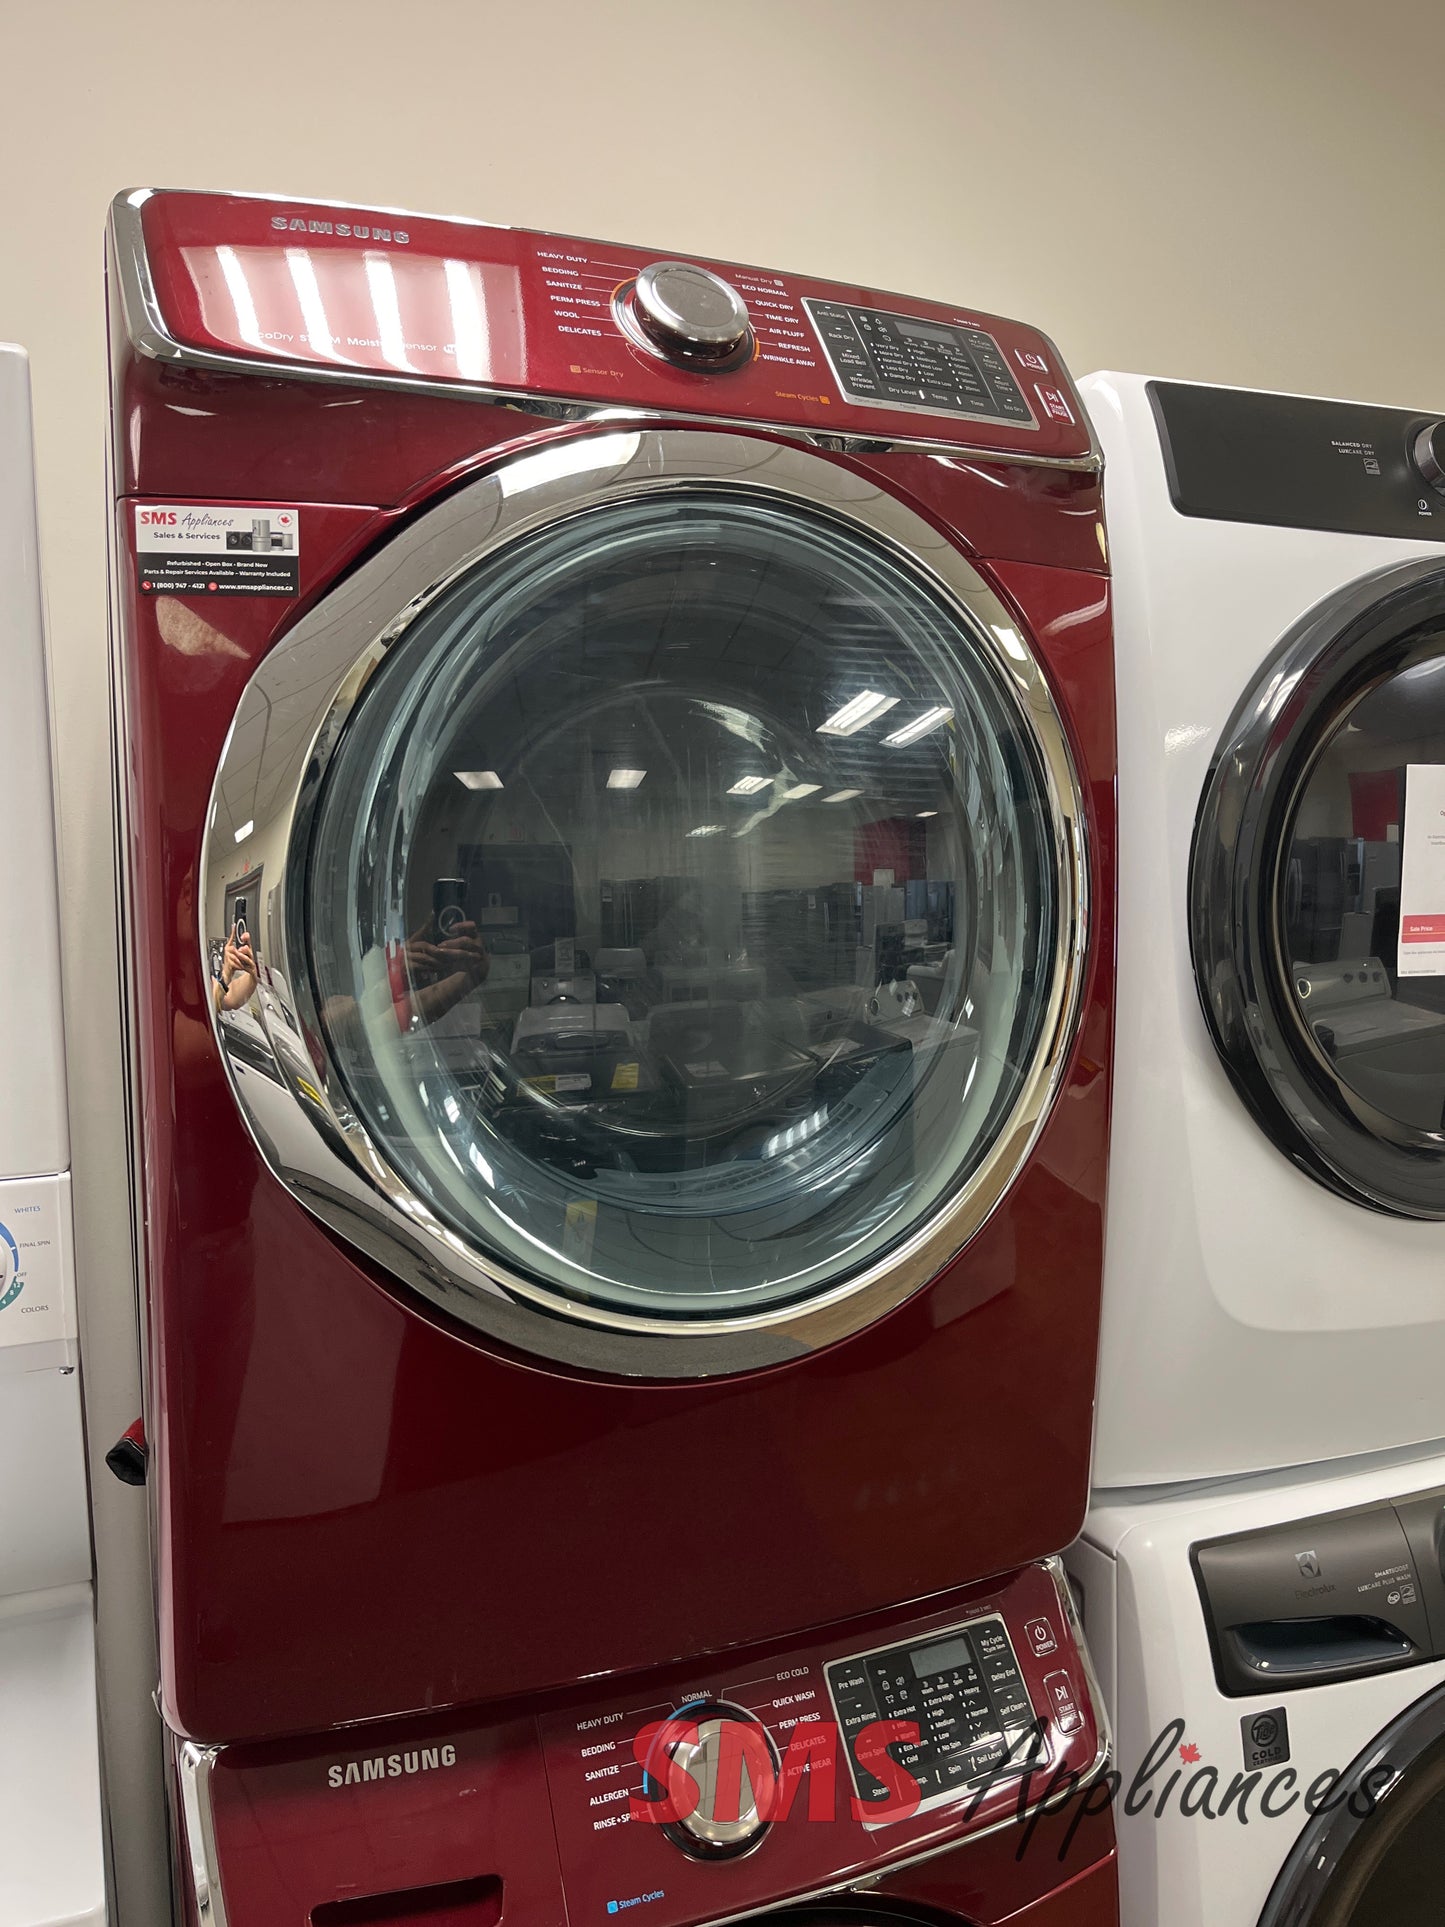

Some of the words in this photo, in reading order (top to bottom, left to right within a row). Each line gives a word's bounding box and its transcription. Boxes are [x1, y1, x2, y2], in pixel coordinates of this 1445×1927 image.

[271, 217, 410, 244] SAMSUNG
[537, 252, 564, 260] HEAVY
[542, 266, 578, 276] BEDDING
[546, 280, 583, 290] SANITIZE
[758, 287, 789, 297] NORMAL
[550, 295, 574, 303] PERM
[576, 299, 600, 307] PRESS
[755, 300, 778, 309] QUICK
[554, 310, 580, 318] WOOL
[765, 314, 783, 322] TIME
[558, 326, 602, 336] DELICATES
[778, 342, 810, 352] REFRESH
[762, 354, 795, 364] WRINKLE
[140, 512, 177, 525] SMS
[182, 512, 234, 530] Appliances
[14, 1205, 40, 1214] WHITES
[20, 1305, 49, 1313] COLORS
[1374, 1564, 1409, 1578] SMARTBOOST
[1358, 1580, 1381, 1592] LUXCARE
[1382, 1578, 1395, 1586] PLUS
[1397, 1574, 1411, 1582] WASH
[1295, 1584, 1337, 1600] Electrolux
[989, 1635, 1003, 1644] Cycle
[1036, 1640, 1054, 1651] POWER
[776, 1671, 790, 1681] ECO
[791, 1666, 809, 1677] COLD
[991, 1672, 1006, 1681] Delay
[1006, 1668, 1016, 1677] End
[838, 1681, 848, 1690] Pre
[848, 1677, 865, 1687] Wash
[682, 1690, 712, 1703] NORMAL
[964, 1686, 980, 1695] Heavy
[772, 1696, 794, 1708] QUICK
[795, 1690, 815, 1702] WASH
[928, 1697, 942, 1706] Extra
[942, 1693, 954, 1701] High
[906, 1705, 916, 1713] Hot
[932, 1709, 945, 1717] High
[970, 1706, 988, 1717] Normal
[1000, 1706, 1011, 1716] Self
[1059, 1703, 1074, 1713] START
[576, 1719, 602, 1731] HEAVY
[604, 1712, 624, 1724] DUTY
[779, 1718, 798, 1730] PERM
[800, 1712, 821, 1724] PRESS
[845, 1716, 861, 1726] Extra
[861, 1712, 877, 1722] Rinse
[935, 1718, 955, 1728] Medium
[790, 1735, 826, 1751] DELICATES
[581, 1742, 616, 1757] BEDDING
[857, 1751, 873, 1761] Extra
[872, 1747, 886, 1756] Spin
[1252, 1747, 1281, 1760] COLD
[906, 1755, 918, 1763] Cold
[977, 1755, 989, 1764] Soil
[988, 1749, 1003, 1760] Level
[328, 1745, 456, 1788] SAMSUNG
[787, 1763, 810, 1777] ACTIVE
[811, 1758, 832, 1769] WEAR
[948, 1765, 962, 1774] Spin
[585, 1765, 620, 1781] SANITIZE
[590, 1789, 629, 1806] ALLERGEN
[872, 1786, 890, 1797] Steam
[594, 1811, 639, 1830] RINSE+SPIN
[619, 1897, 641, 1909] Steam
[642, 1890, 665, 1902] Cycles
